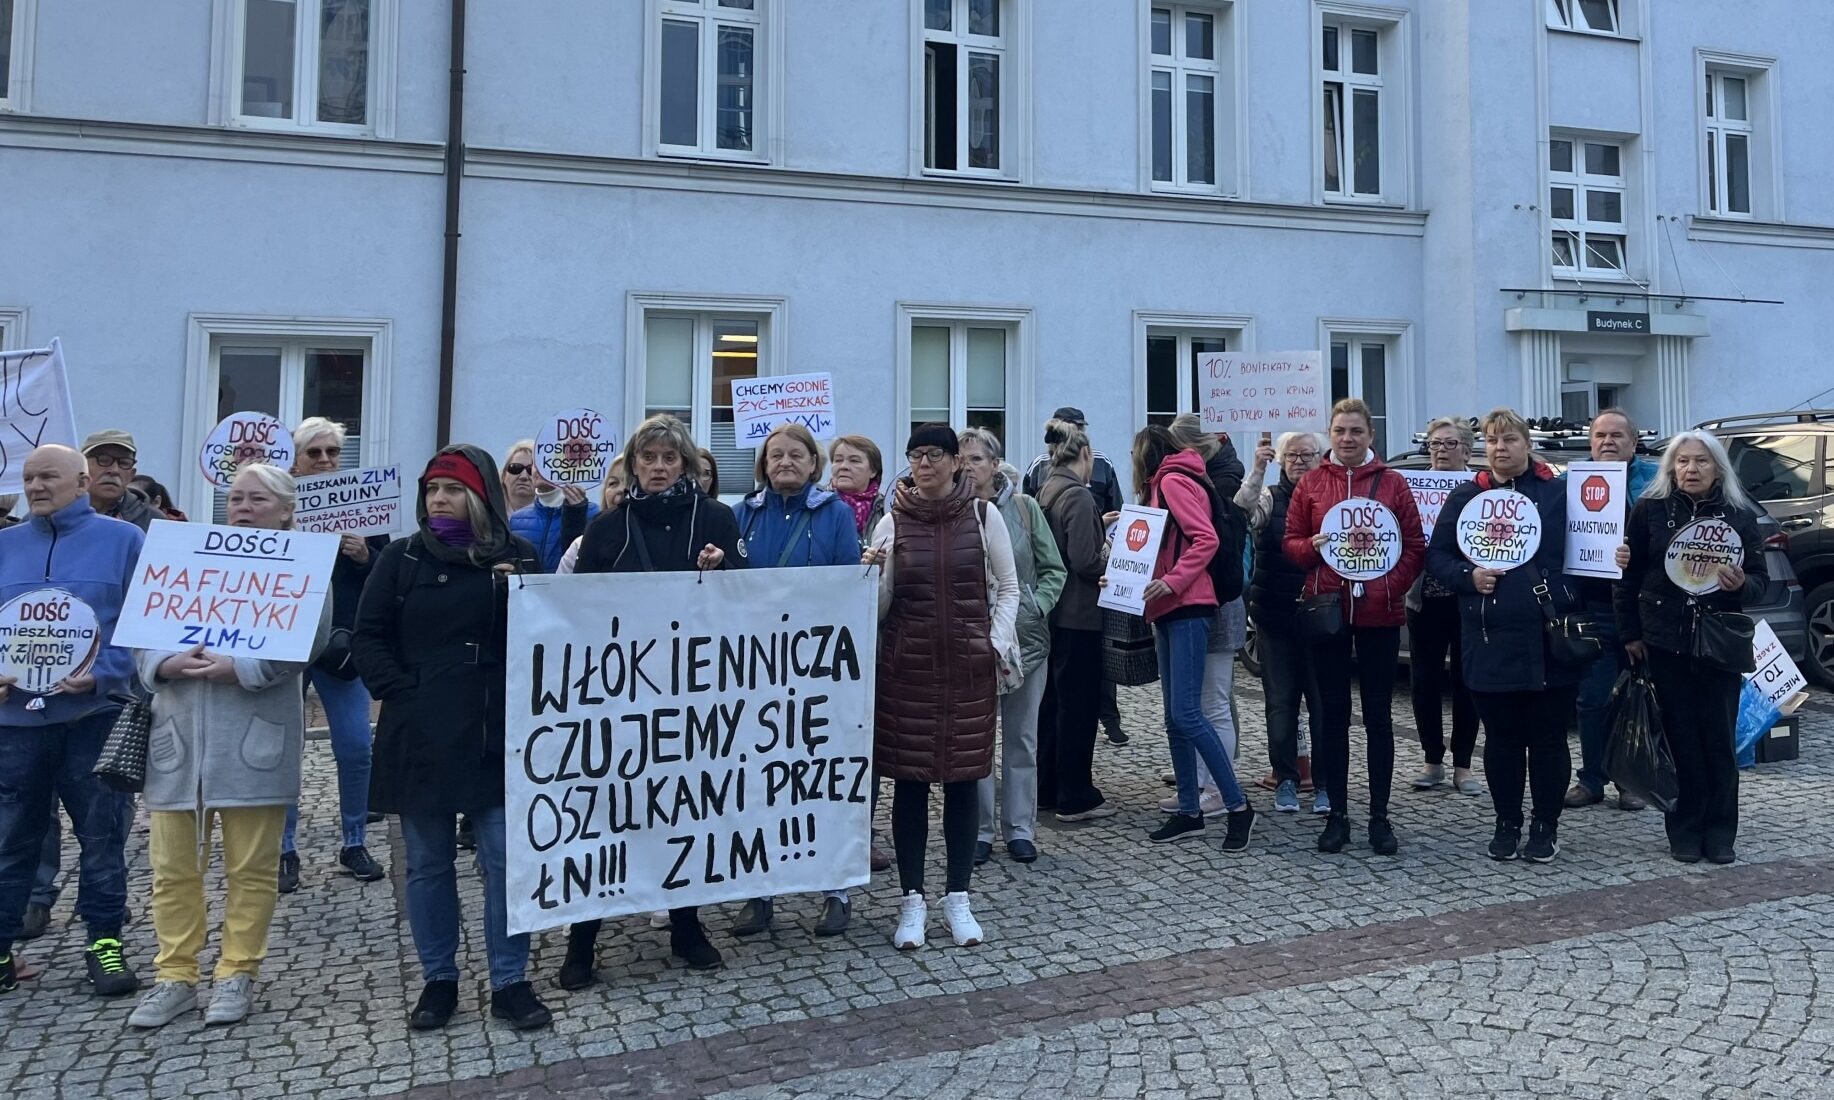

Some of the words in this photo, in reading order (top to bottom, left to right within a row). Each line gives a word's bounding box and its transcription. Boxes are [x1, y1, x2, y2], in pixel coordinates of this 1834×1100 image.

[1595, 317, 1633, 330] Budynek
[1635, 319, 1643, 329] C
[1205, 358, 1233, 379] 10%
[1240, 362, 1292, 374] BONIFIKATY
[736, 383, 785, 397] CHCEMY
[785, 380, 830, 394] GODNIE
[1242, 387, 1257, 398] CO
[1264, 387, 1276, 396] TO
[1286, 385, 1315, 396] KPINA
[1268, 408, 1280, 420] NA
[229, 417, 280, 445] DOŚĆ
[557, 412, 602, 441] DOŚĆ
[747, 421, 772, 436] JAK
[543, 455, 607, 469] kosztów
[361, 467, 397, 486] ZLM
[1405, 477, 1471, 489] PREZYDEN
[298, 494, 322, 510] TO
[328, 484, 383, 506] RUINY
[1585, 486, 1606, 501] STOP
[367, 502, 397, 513] ŻYCIU
[1341, 502, 1384, 530] DOŚĆ
[1480, 494, 1527, 521] DOŚĆ
[1129, 528, 1147, 543] STOP
[1568, 520, 1618, 535] KŁAMSTWOM
[1693, 522, 1732, 543] DOŚĆ
[203, 530, 291, 557] DOŚĆ!
[1463, 532, 1529, 549] kosztów
[1672, 539, 1742, 555] mieszkania
[1329, 544, 1390, 558] kosztów
[1579, 548, 1603, 563] ZLM!!!
[1667, 551, 1679, 560] w
[1110, 557, 1150, 576] KŁAMSTWOM
[142, 563, 310, 599] MAFIJNEJ
[20, 596, 71, 622] DOŚĆ
[143, 591, 299, 631] PRAKTYKI
[0, 624, 94, 639] mieszkania
[178, 625, 267, 650] ZLM-U
[531, 613, 861, 716] WŁÓKIENNICZA
[523, 698, 746, 785] CZUJEMY
[754, 687, 829, 757] SIĘ
[527, 753, 746, 852] OSZUKANI
[761, 756, 870, 807] PRZEZ
